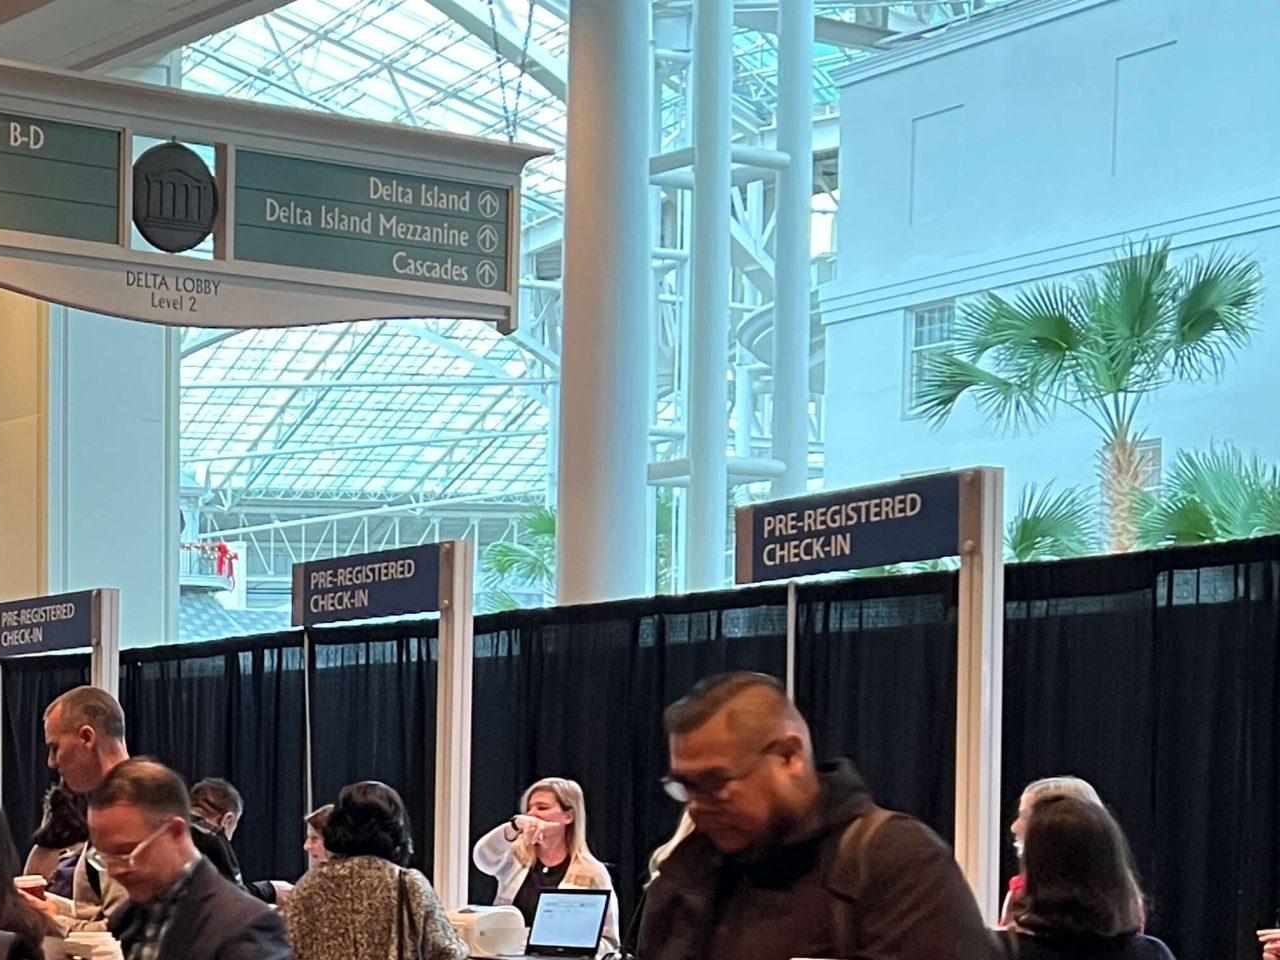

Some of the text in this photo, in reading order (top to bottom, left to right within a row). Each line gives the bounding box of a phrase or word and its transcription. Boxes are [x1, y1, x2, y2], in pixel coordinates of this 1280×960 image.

[10, 122, 45, 149] B-D
[370, 177, 470, 212] Delta Island
[265, 198, 469, 247] Delta Island Mezzanine
[392, 251, 468, 282] Cascades
[126, 270, 221, 296] DELTA LOBBY
[151, 291, 197, 312] Level 2
[763, 492, 922, 538] PRE-REGISTERED
[762, 532, 851, 567] CHECK-IN
[310, 559, 415, 590] PRE-REGISTERED
[1, 602, 76, 628] PRE-REGISTERED
[310, 588, 369, 613] CHECK-IN
[1, 626, 43, 647] CHECK-IN
